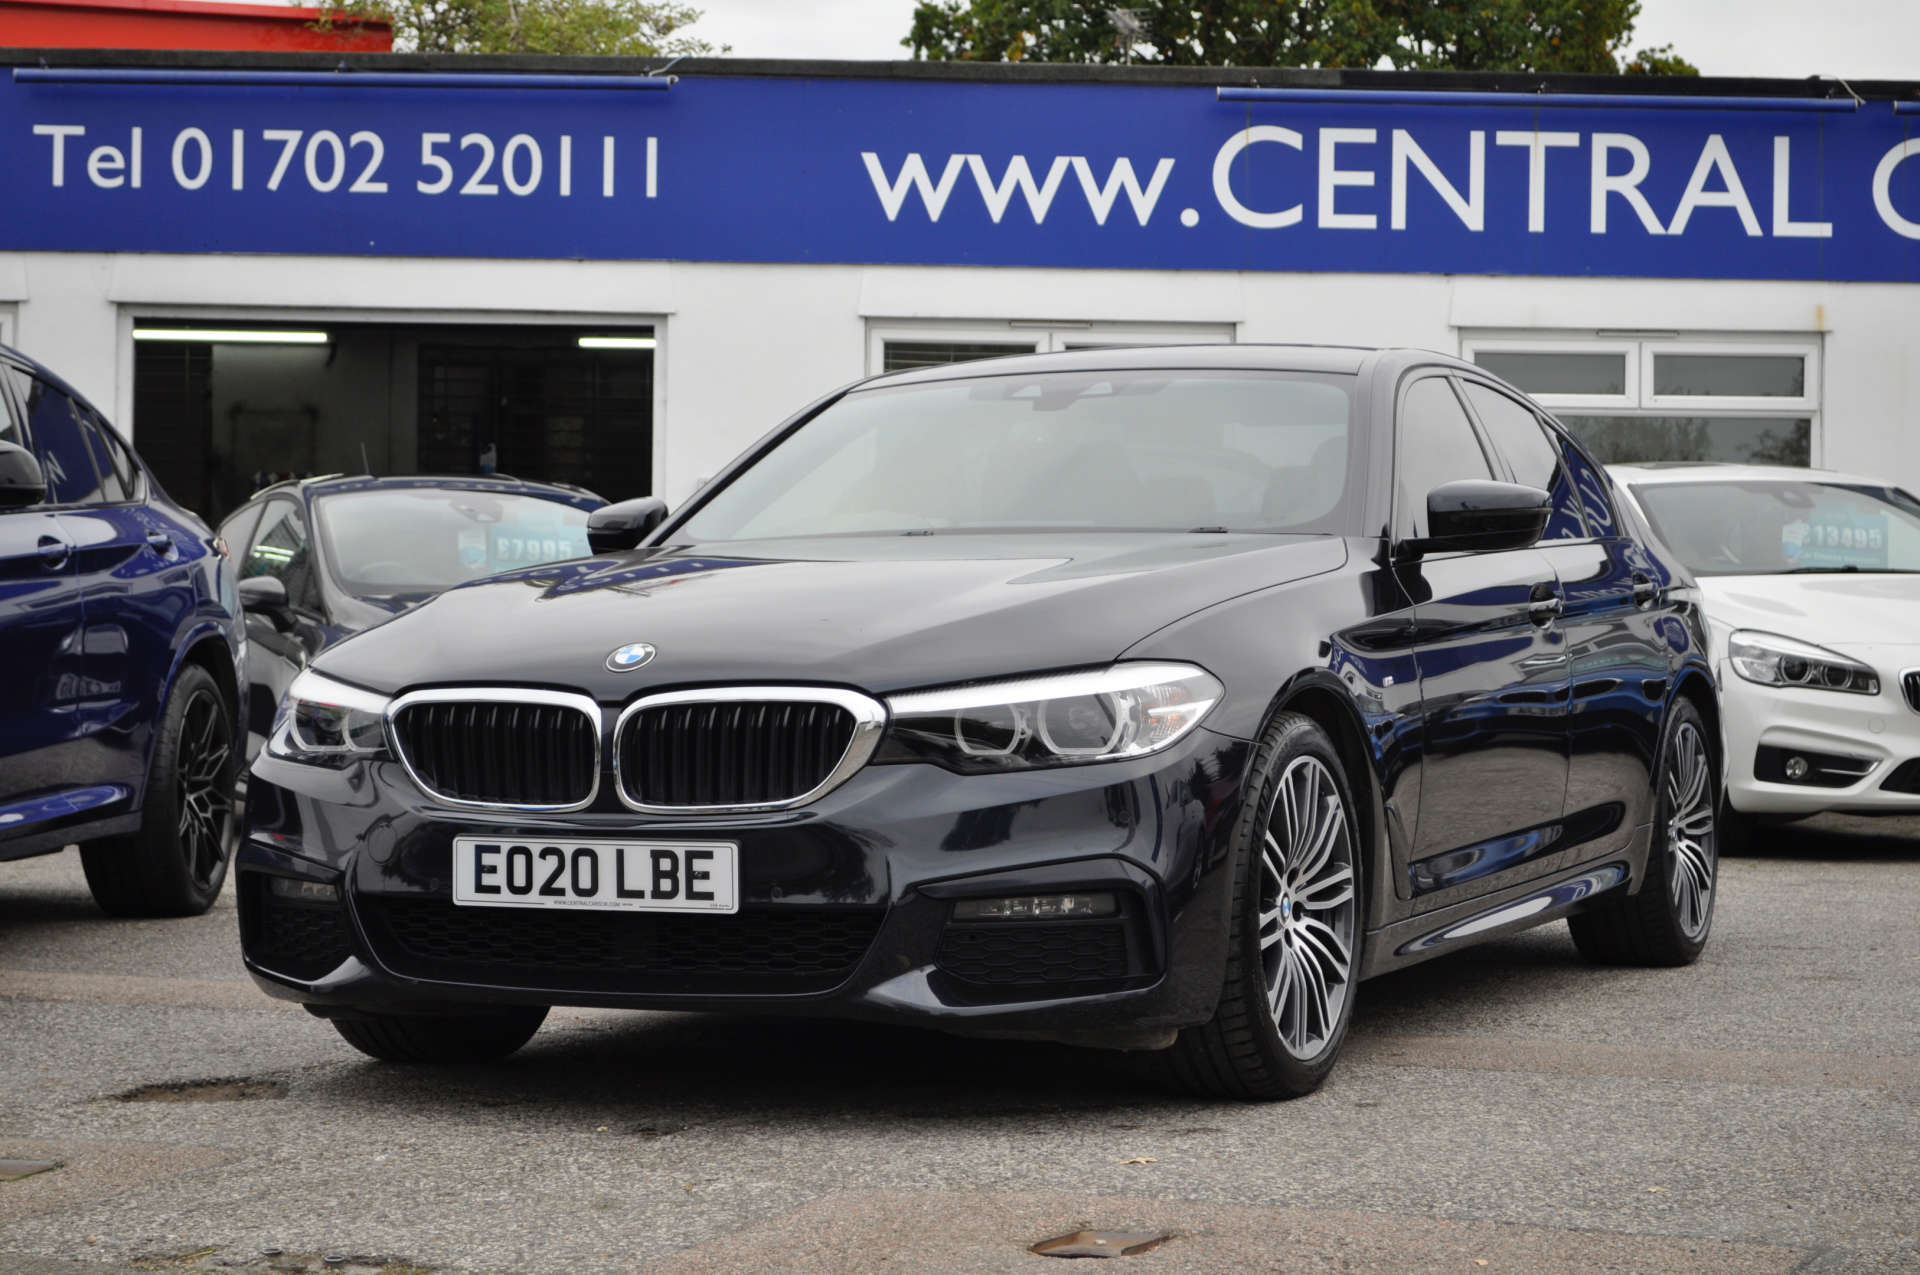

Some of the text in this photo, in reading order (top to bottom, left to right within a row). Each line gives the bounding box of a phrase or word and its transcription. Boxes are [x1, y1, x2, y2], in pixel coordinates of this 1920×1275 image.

[33, 124, 658, 198] Tel 01702 520111
[615, 848, 715, 901] LBE
